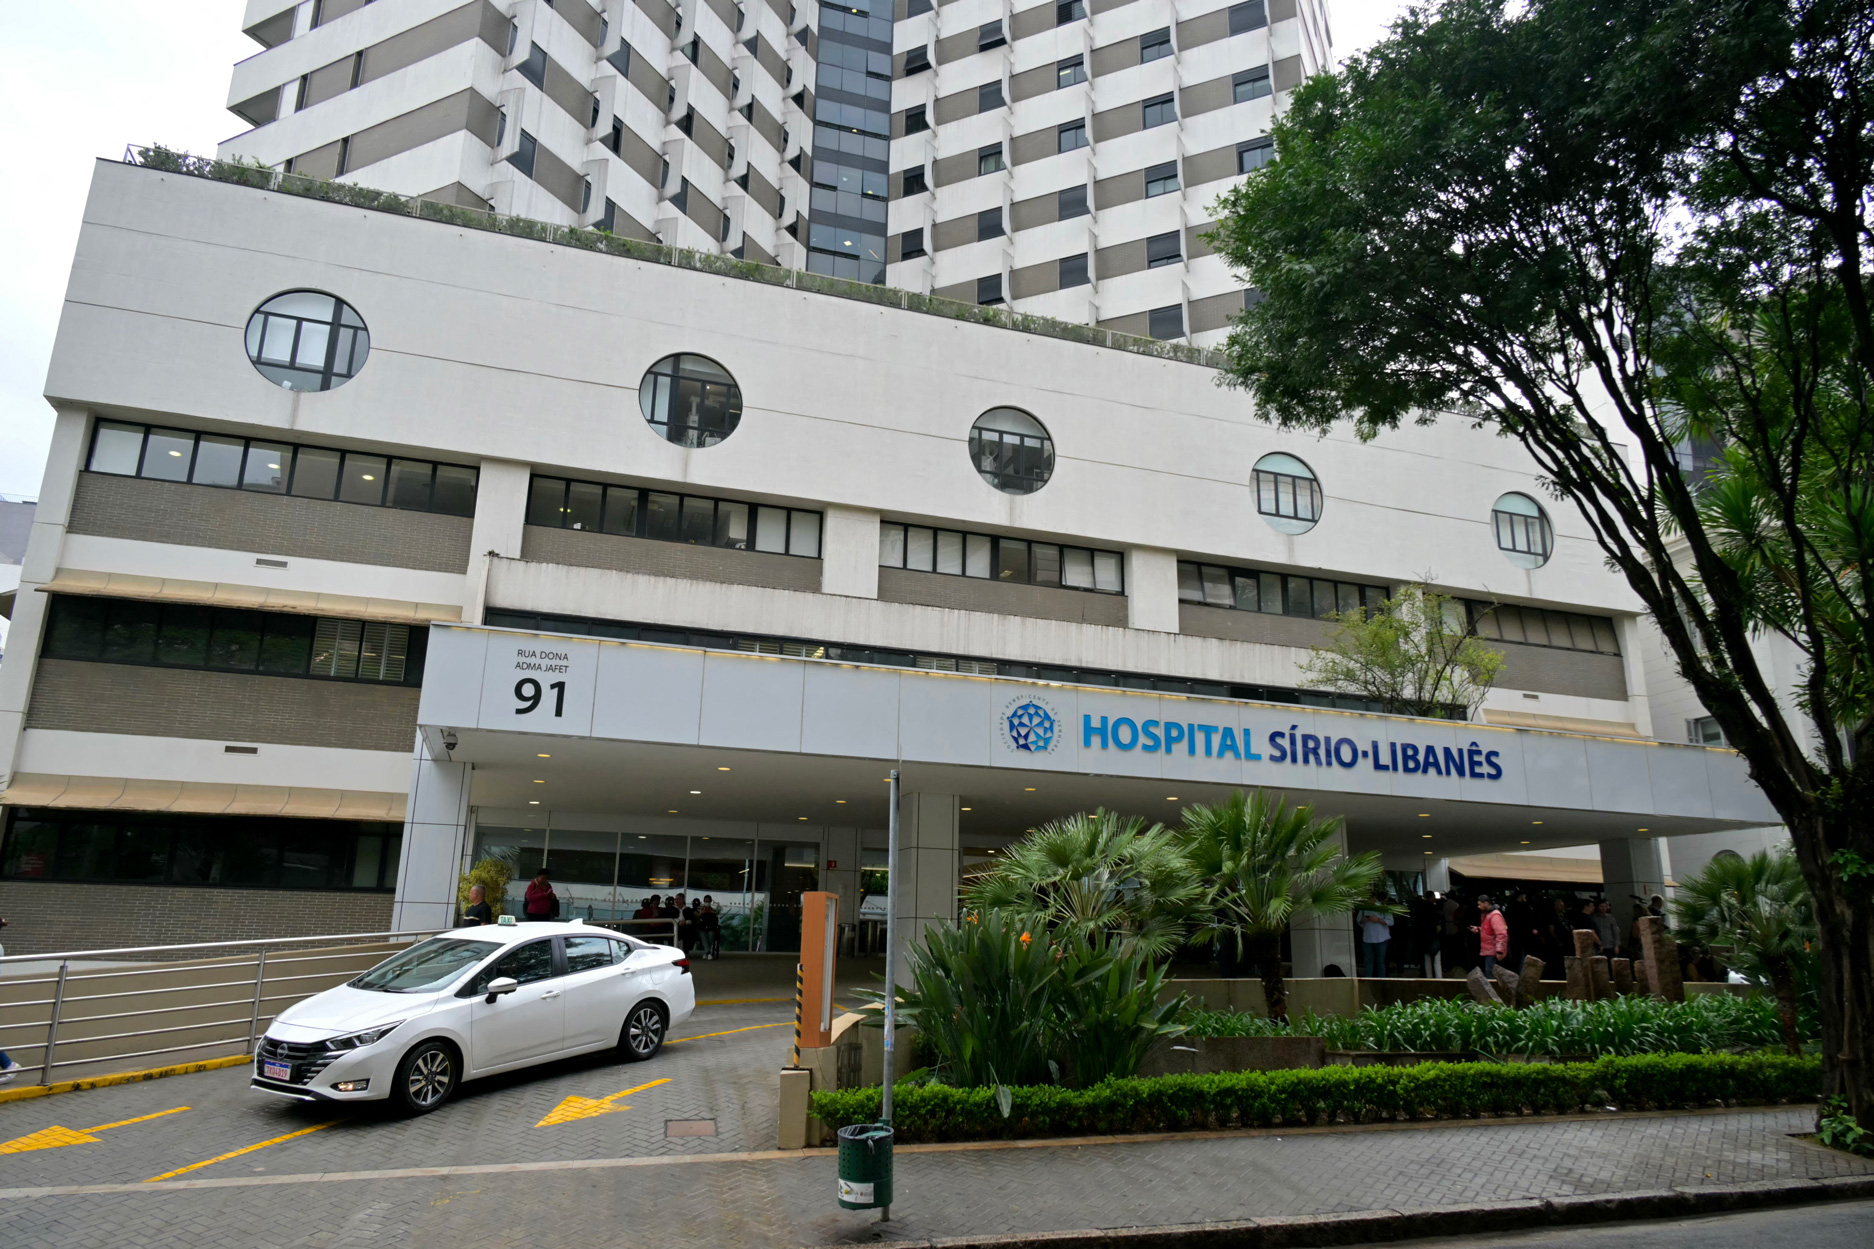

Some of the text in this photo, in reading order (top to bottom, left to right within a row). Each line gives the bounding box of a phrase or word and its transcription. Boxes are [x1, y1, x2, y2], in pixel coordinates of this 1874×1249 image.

[517, 649, 569, 661] RUA DONA
[515, 661, 569, 674] ADMA JAFET
[514, 677, 566, 718] 91
[1083, 714, 1262, 761] HOSPITAL
[500, 916, 513, 924] TAXI
